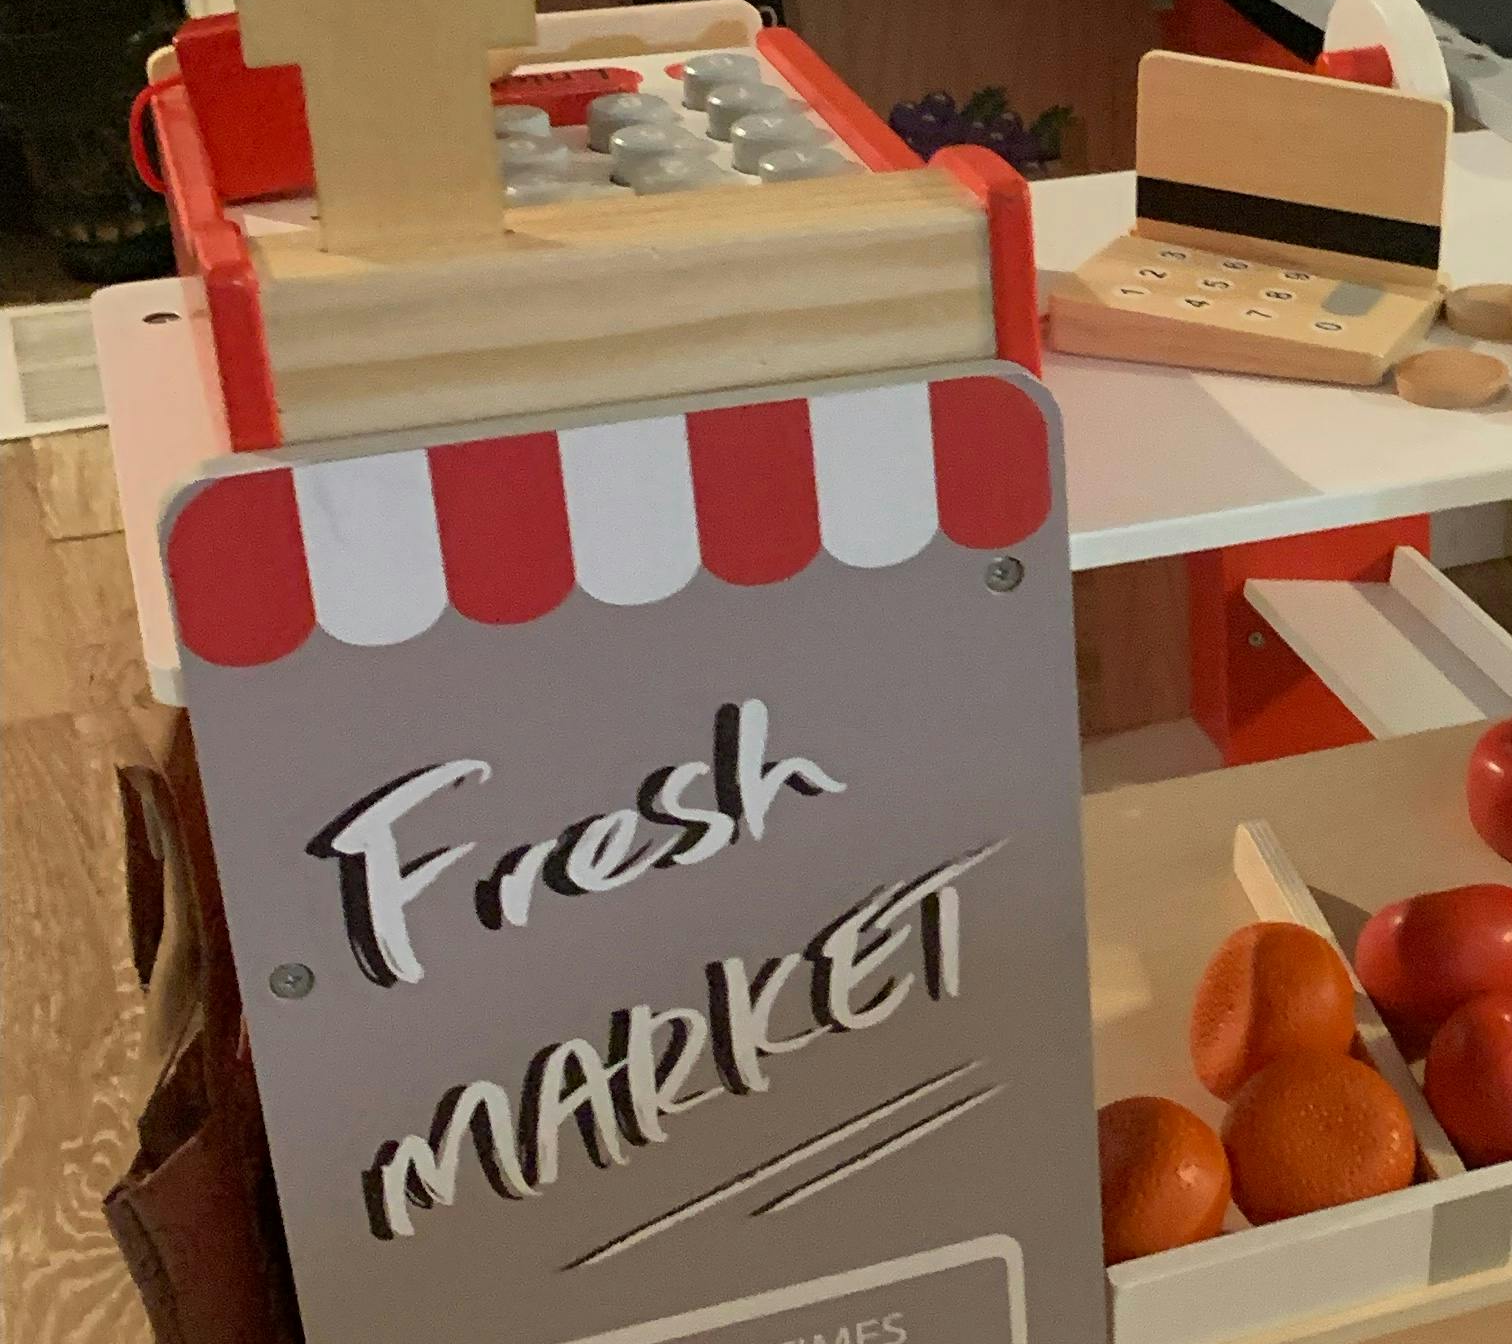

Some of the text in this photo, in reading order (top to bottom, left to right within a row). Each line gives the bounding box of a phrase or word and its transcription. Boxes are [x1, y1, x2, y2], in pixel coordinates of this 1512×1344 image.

[1139, 268, 1168, 279] 2
[1203, 278, 1230, 289] 5
[1184, 297, 1211, 309] 4
[306, 698, 847, 988] Fresh
[361, 836, 1010, 1240] MARKET
